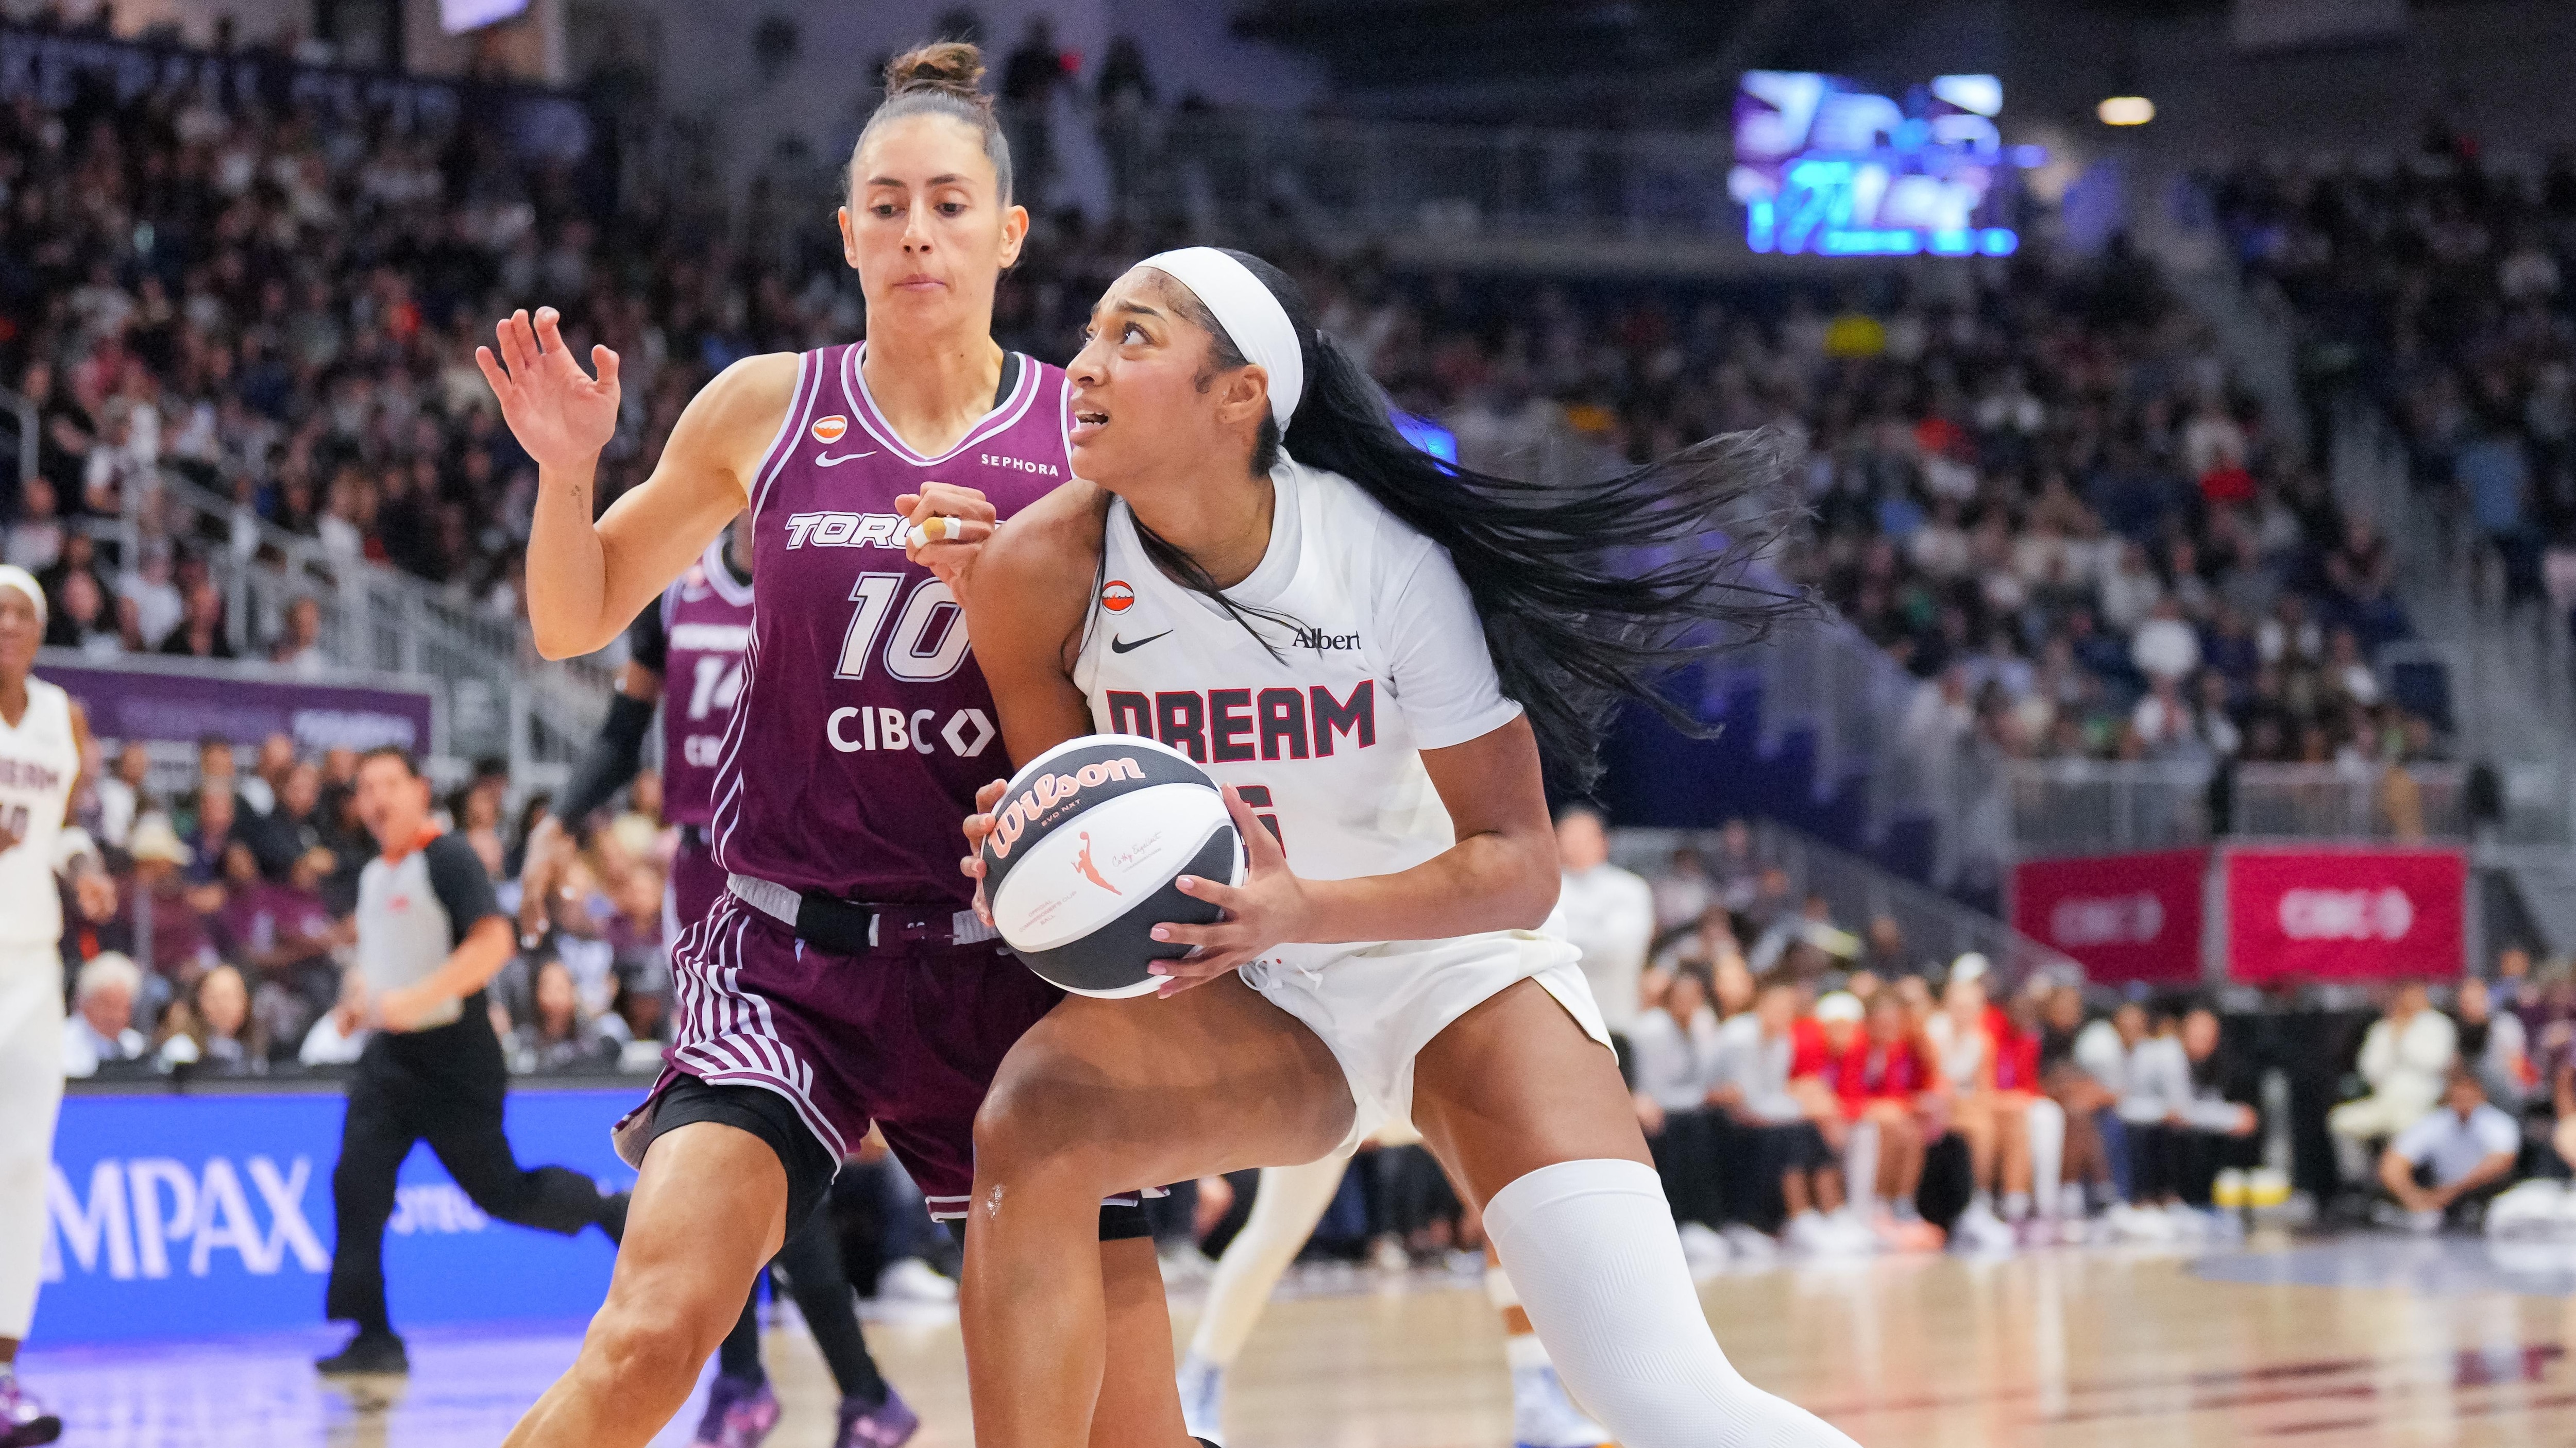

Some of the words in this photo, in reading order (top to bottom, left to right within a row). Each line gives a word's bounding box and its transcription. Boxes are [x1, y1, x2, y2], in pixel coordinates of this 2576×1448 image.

[981, 453, 1059, 477] SEPHORA
[833, 571, 972, 683] 10
[1292, 627, 1362, 650] Albert
[826, 706, 936, 755] CIBC
[1106, 679, 1376, 764] DREAM
[988, 756, 1146, 860] Wilson
[1041, 811, 1060, 828] EVO
[1061, 799, 1081, 813] NXT
[1062, 891, 1077, 903] CUP
[1040, 914, 1056, 925] BALL
